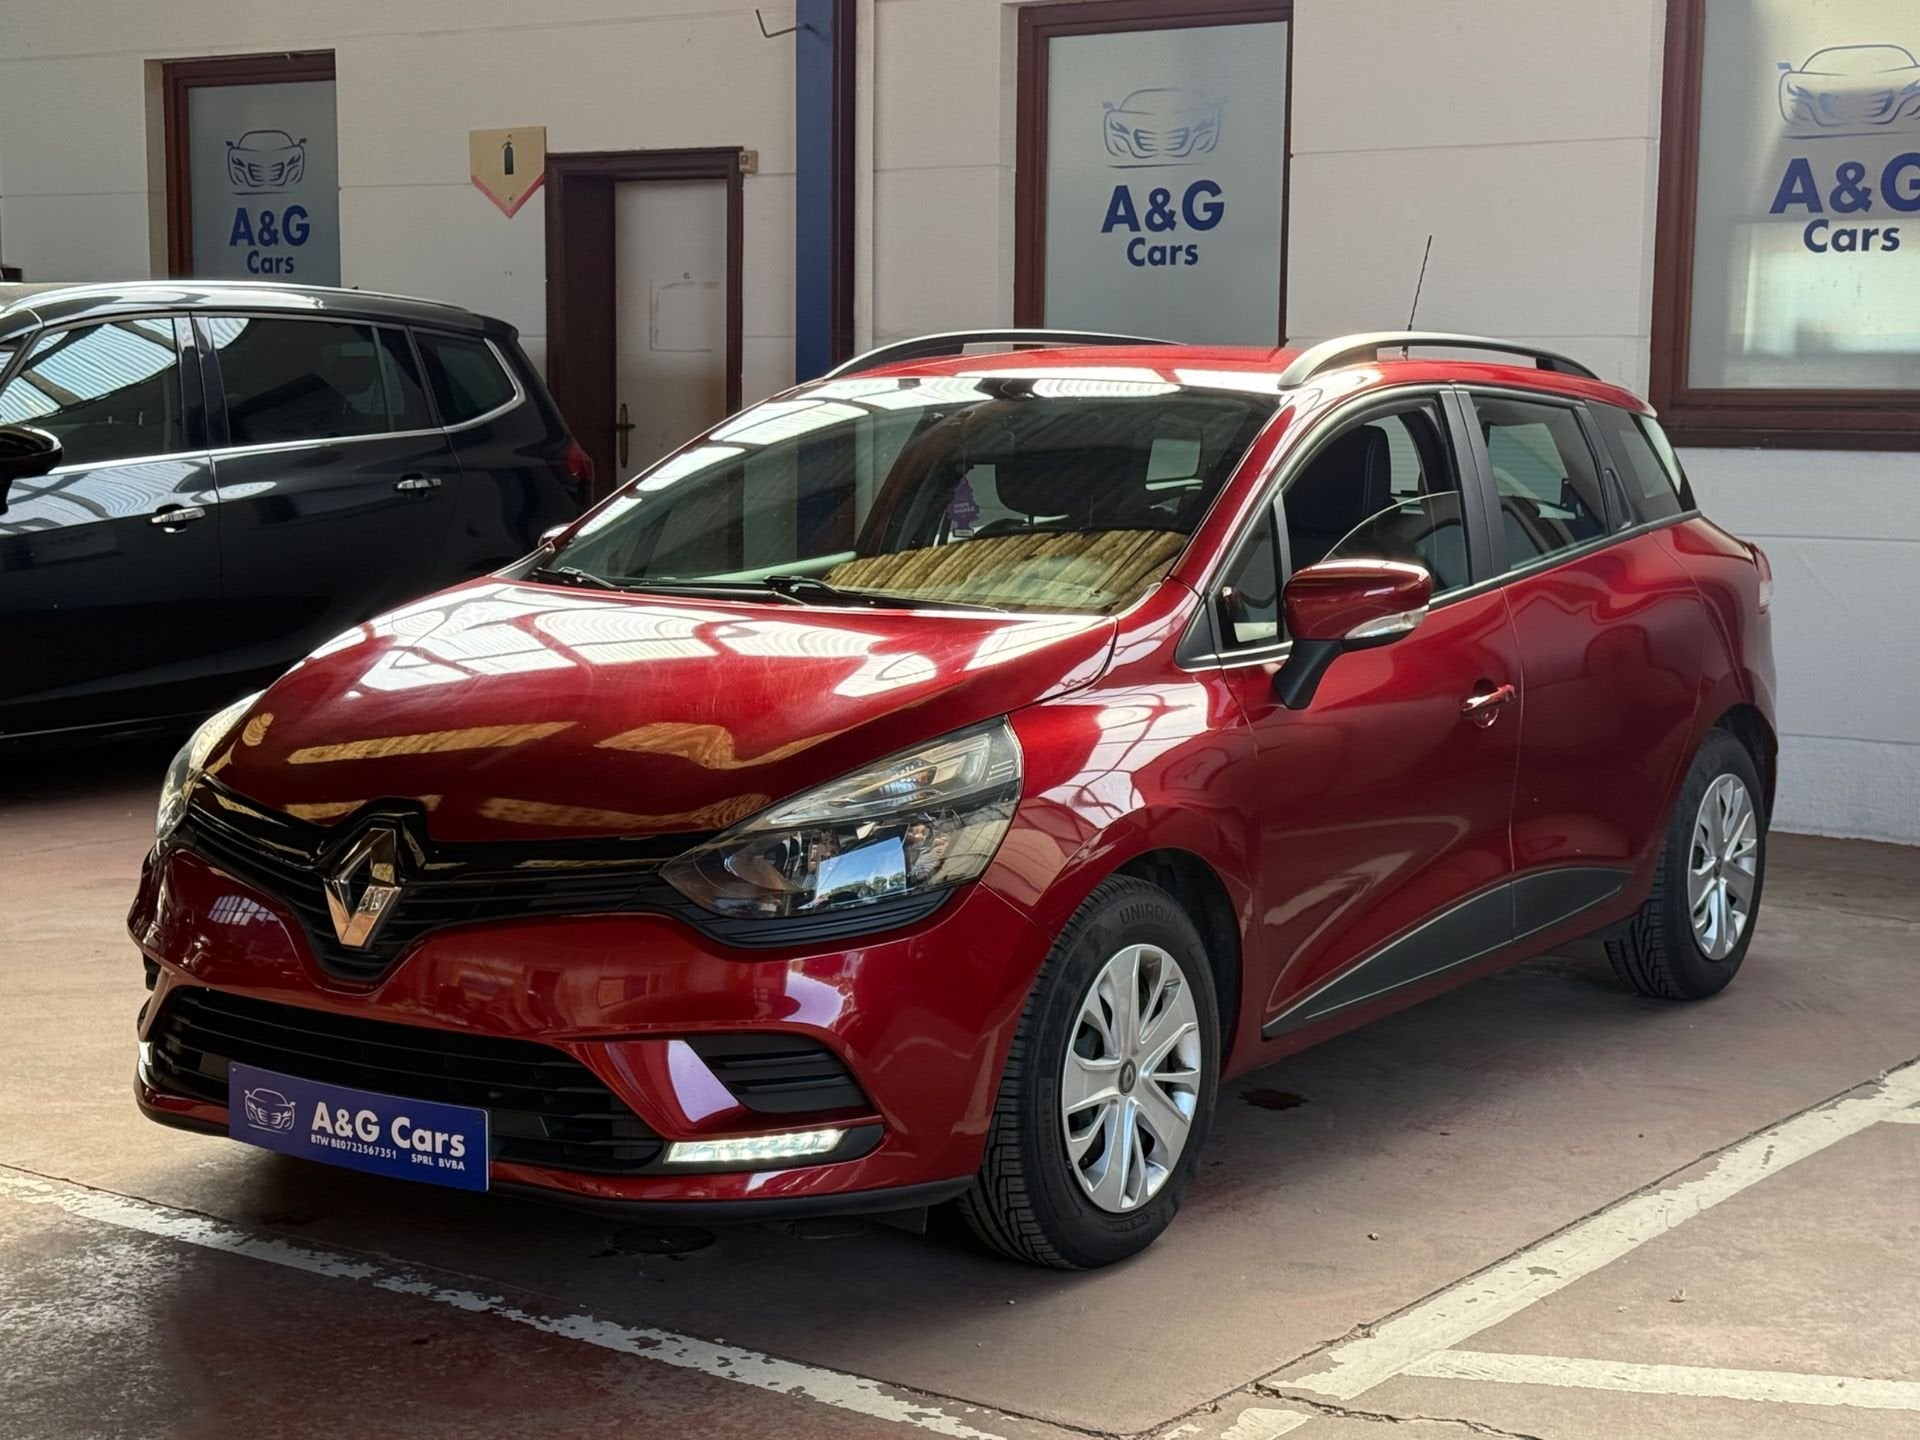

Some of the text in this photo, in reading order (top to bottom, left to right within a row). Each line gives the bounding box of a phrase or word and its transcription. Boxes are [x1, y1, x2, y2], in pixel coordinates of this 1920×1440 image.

[1769, 151, 1920, 214] A&G
[1101, 179, 1225, 233] A&G
[229, 204, 310, 247] A&G
[1803, 218, 1901, 254] Cars
[247, 249, 295, 274] Cars
[1127, 236, 1199, 267] Cars
[1119, 902, 1184, 927] UNIROYA
[311, 1101, 466, 1158] A&G Cars
[311, 1134, 465, 1171] BTW BE0722567351 SPRL BVBA
